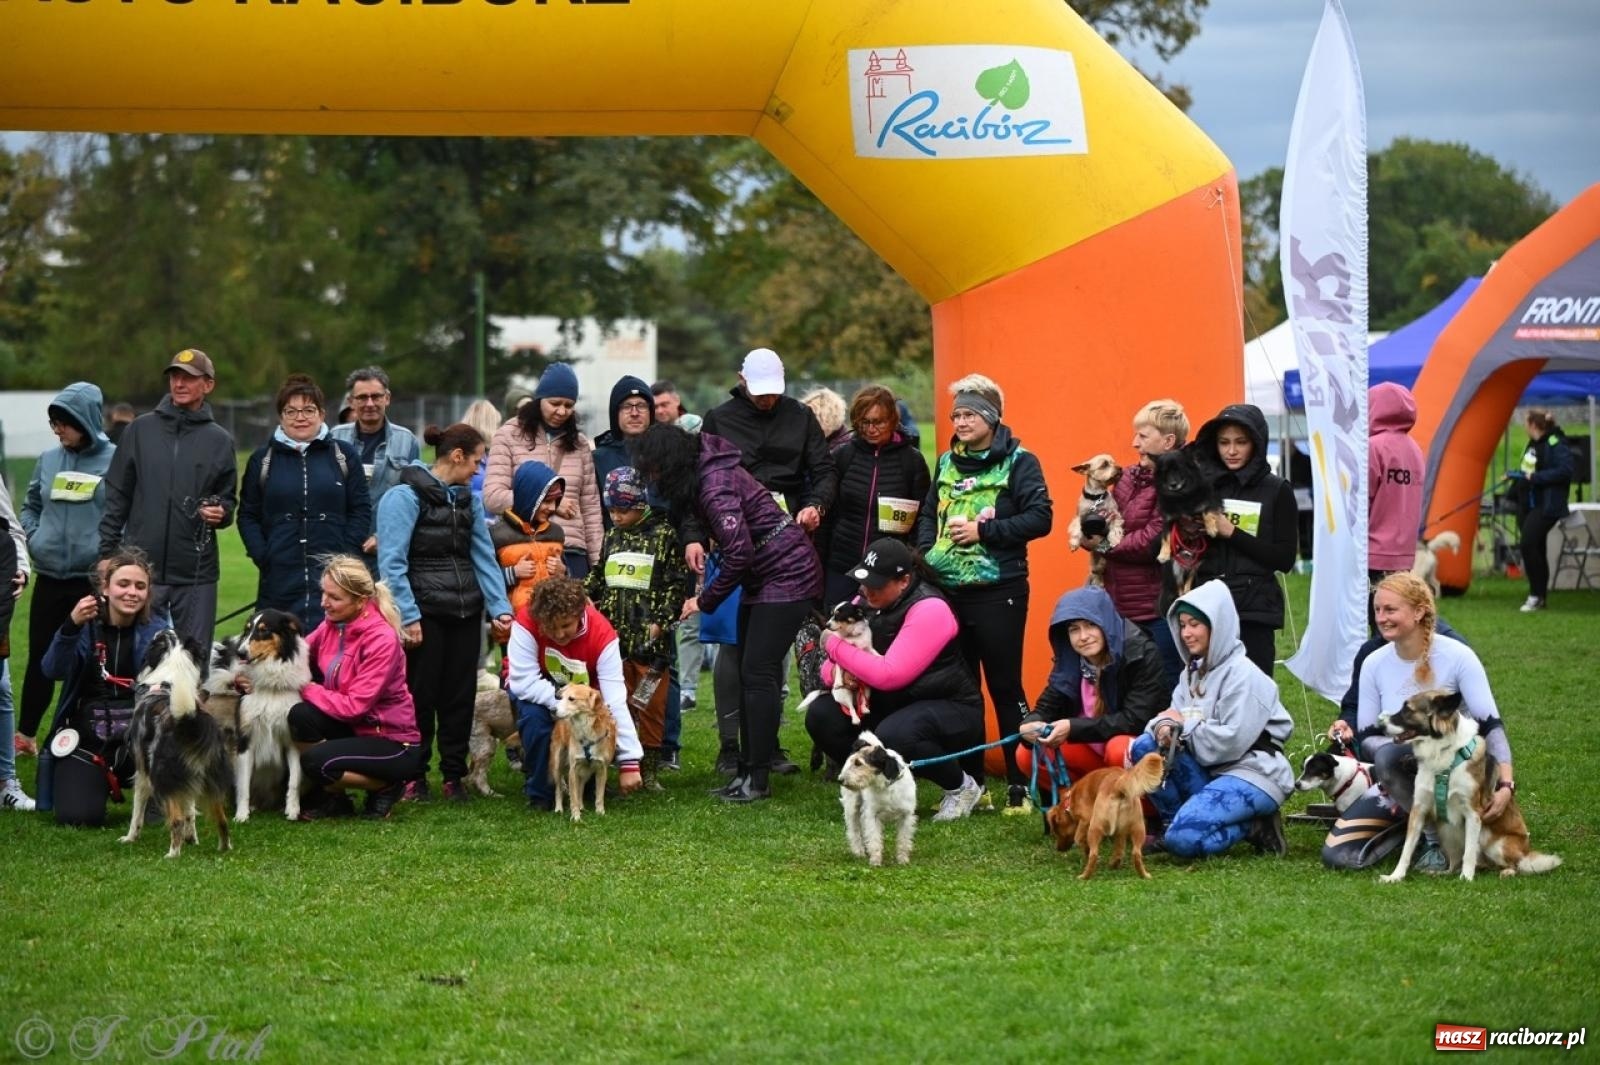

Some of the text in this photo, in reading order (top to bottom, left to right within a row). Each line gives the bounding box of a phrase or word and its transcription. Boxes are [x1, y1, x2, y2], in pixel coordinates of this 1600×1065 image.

[876, 90, 1073, 156] Racibórz
[65, 480, 83, 491] 87
[893, 509, 907, 522] 88
[1223, 512, 1240, 526] 8
[617, 564, 636, 576] 79
